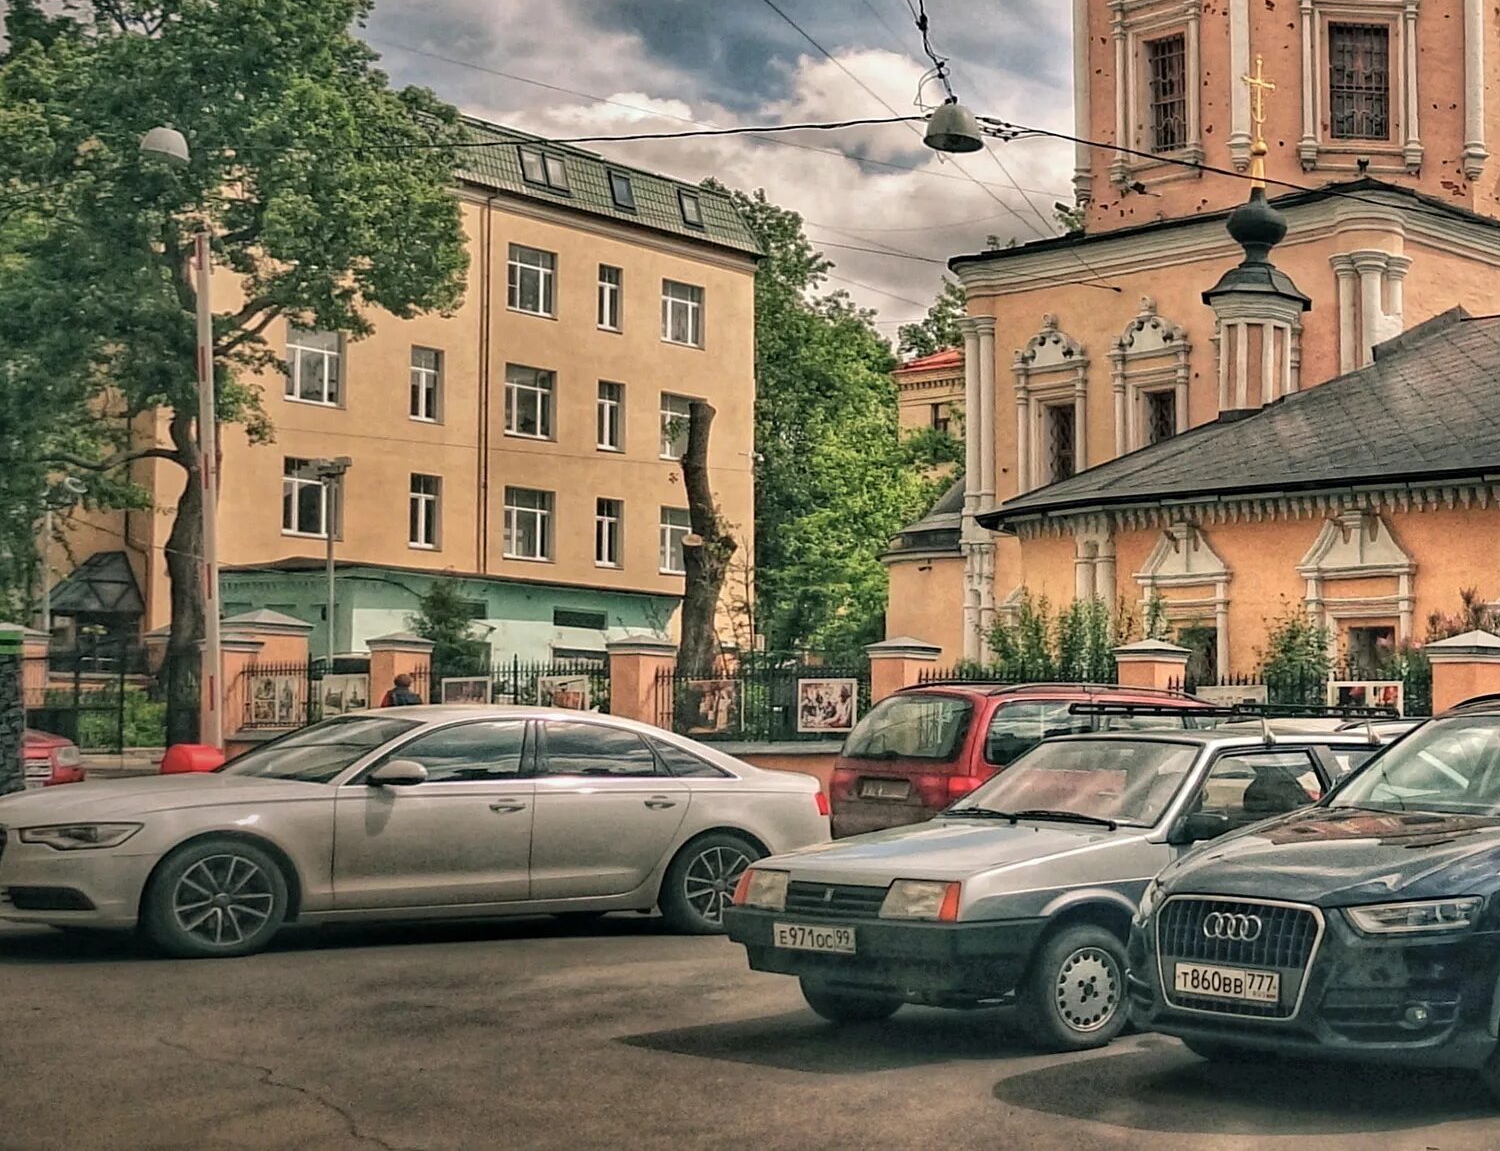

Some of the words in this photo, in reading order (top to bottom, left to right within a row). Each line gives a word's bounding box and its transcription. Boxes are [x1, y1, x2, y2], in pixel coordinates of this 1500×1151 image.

[780, 927, 833, 949] Е971ОС
[836, 930, 850, 945] 99
[1181, 969, 1243, 995] Т860ВВ
[1247, 973, 1275, 992] 777
